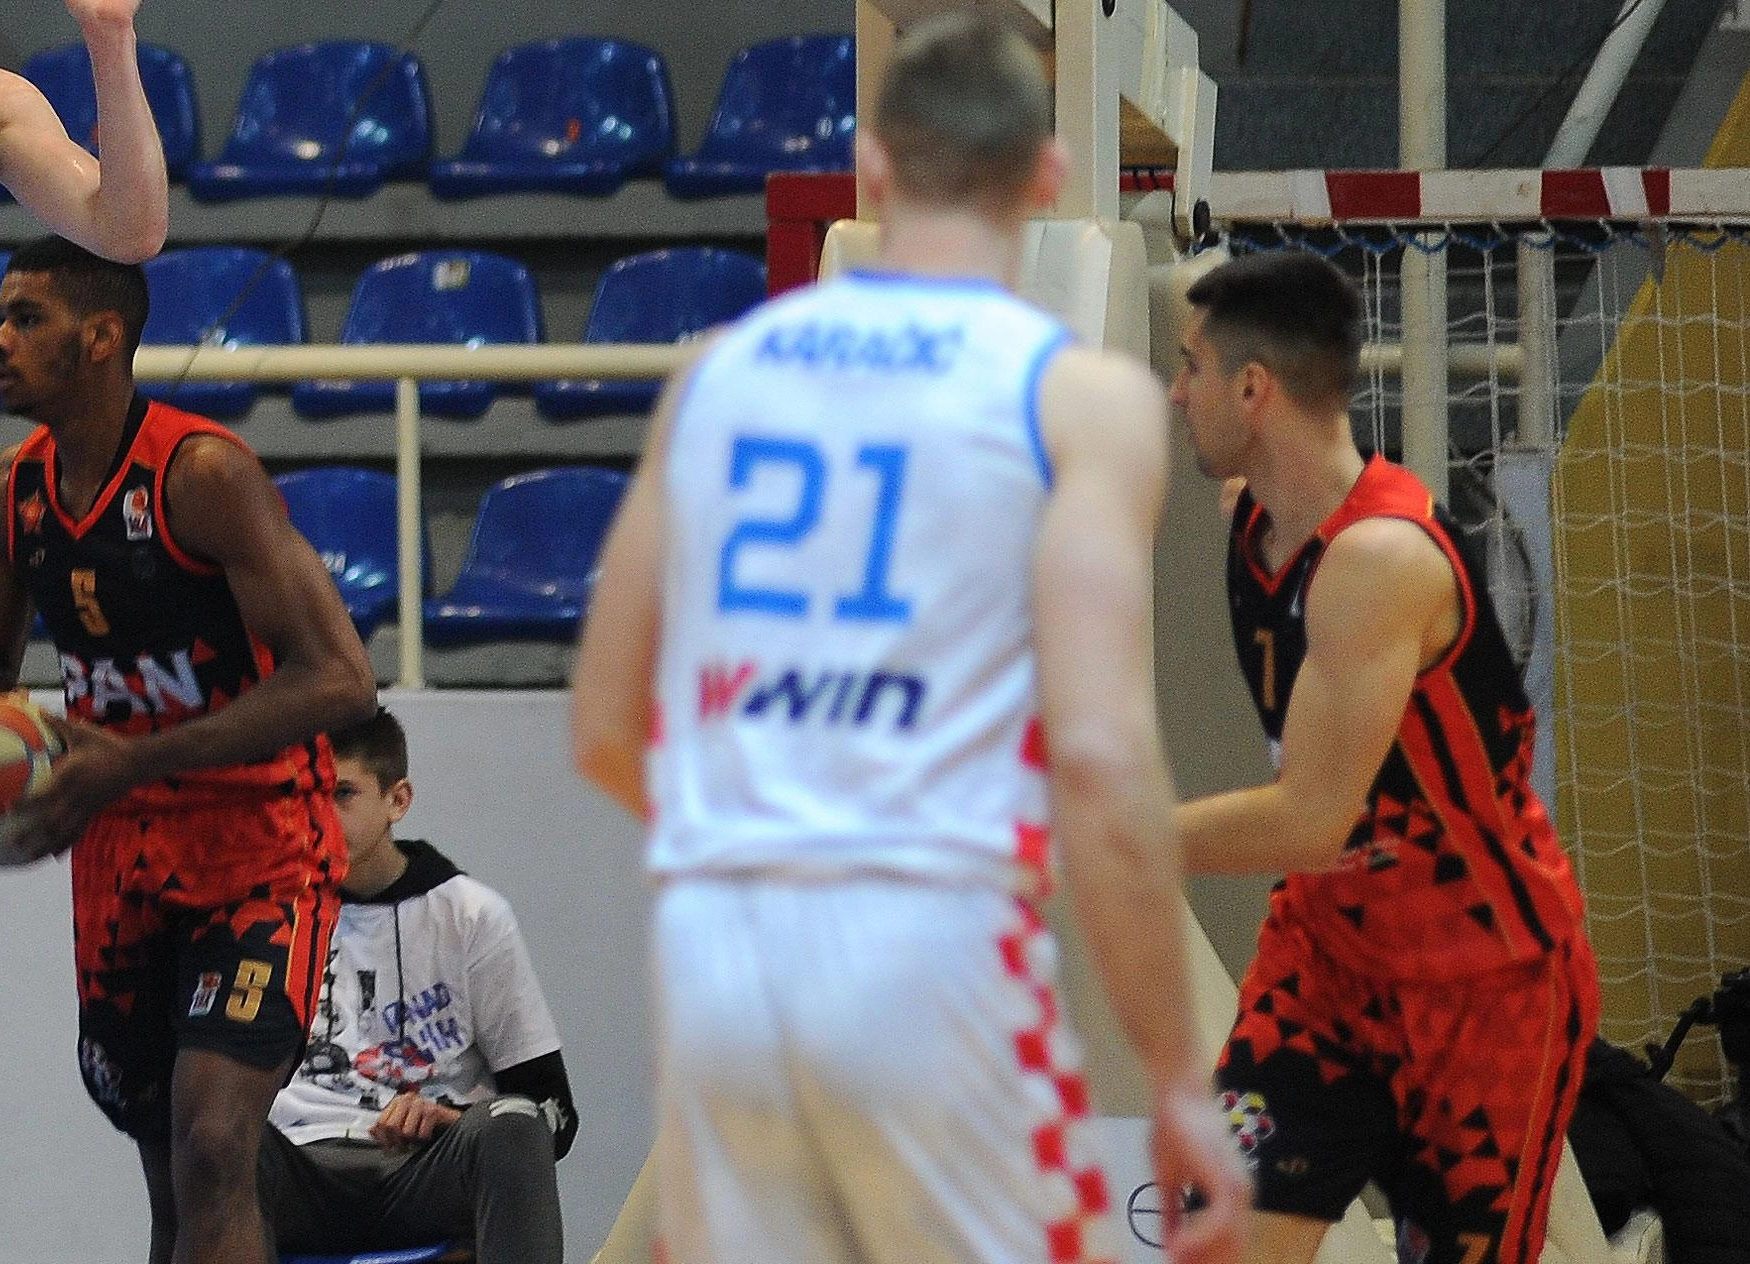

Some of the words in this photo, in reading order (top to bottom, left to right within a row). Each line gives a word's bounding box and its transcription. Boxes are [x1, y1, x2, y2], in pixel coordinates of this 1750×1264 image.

[718, 438, 912, 621] 21
[71, 568, 111, 636] 5
[61, 648, 204, 715] PAN
[225, 960, 274, 1022] 5
